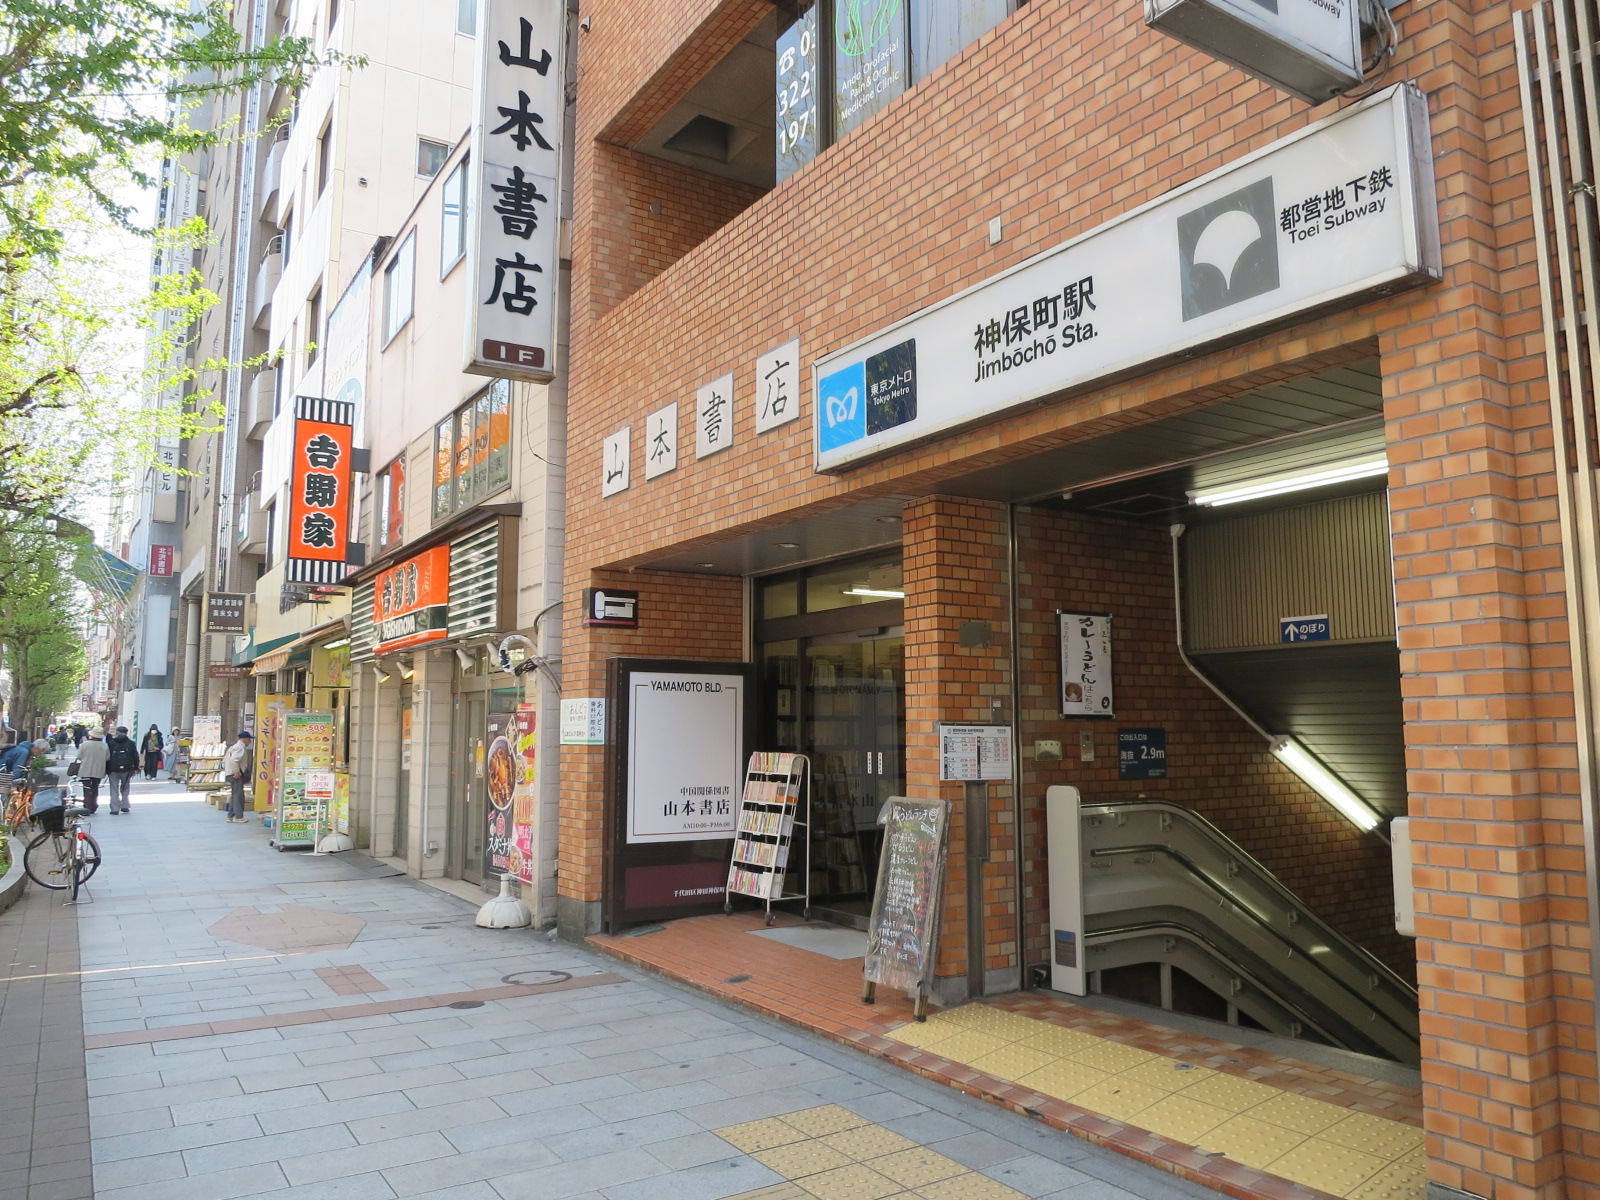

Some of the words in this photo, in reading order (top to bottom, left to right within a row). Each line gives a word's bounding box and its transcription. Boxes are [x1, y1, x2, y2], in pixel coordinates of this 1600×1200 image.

[1308, 0, 1340, 18] ubway
[801, 23, 815, 56] 0
[842, 71, 861, 92] Ando
[863, 37, 899, 74] Orofacial
[841, 90, 875, 121] Medicine
[876, 70, 900, 93] Clinic
[850, 82, 866, 101] Pain
[872, 61, 889, 81] Oral
[483, 17, 554, 316] 山本書店
[1279, 165, 1394, 232] 都営地下鉄
[1288, 220, 1320, 245] Toei
[1324, 197, 1387, 231] Subway
[974, 275, 1097, 358] 神保町駅
[974, 334, 1057, 383] Jimbōchō
[1062, 320, 1098, 349] Sta.
[870, 369, 912, 398] 東京メトロ
[873, 392, 891, 406] Tokyo
[890, 385, 910, 399] Metro
[161, 451, 173, 491] 北ビル
[382, 614, 415, 641] YOSHINOYA
[1299, 623, 1326, 634] のぼり
[650, 680, 702, 693] YAMAMOTO
[704, 682, 723, 693] BLD.
[596, 701, 604, 734] あんどう
[1119, 733, 1148, 741] この出入口は
[1120, 750, 1135, 760] 海抜
[1140, 745, 1165, 760] 2.9m
[680, 786, 730, 797] 中国関係図書
[663, 799, 730, 817] 山本書店
[673, 886, 725, 898] 千代田区神田神保町
